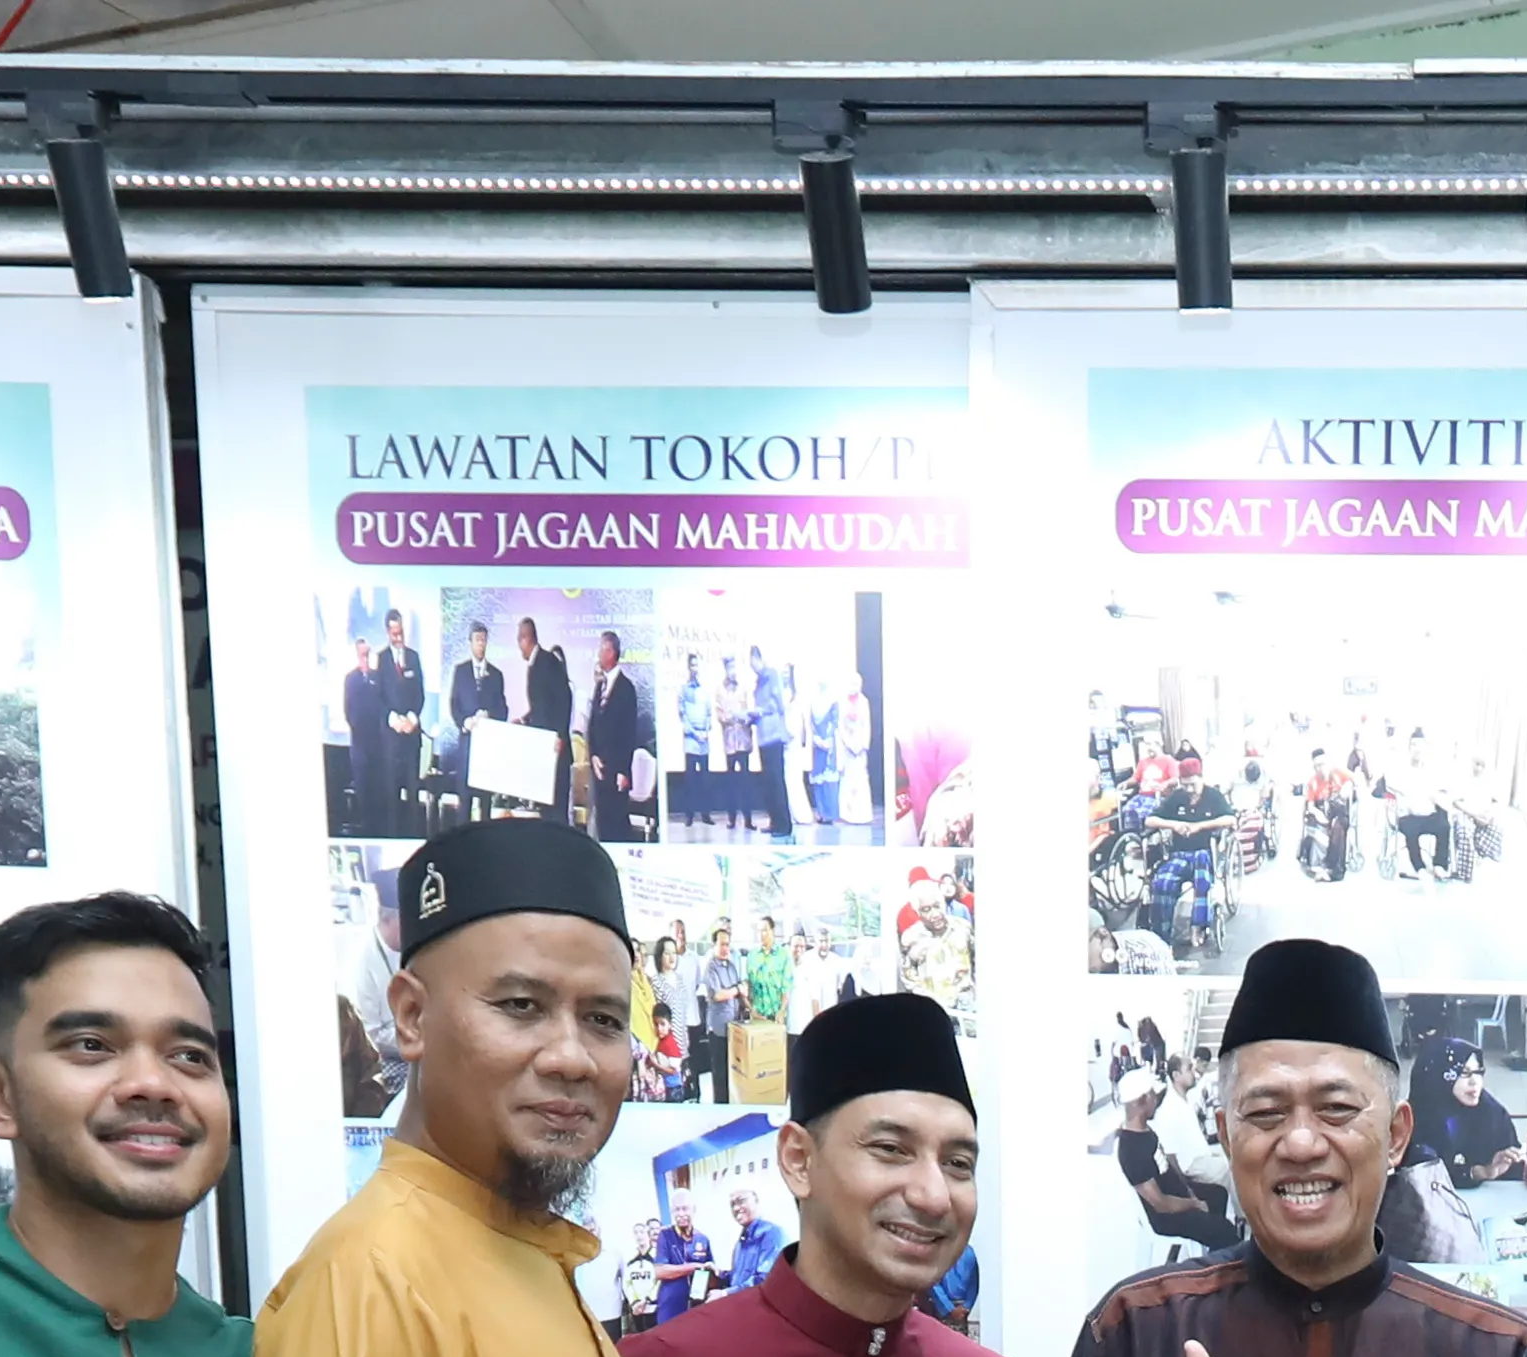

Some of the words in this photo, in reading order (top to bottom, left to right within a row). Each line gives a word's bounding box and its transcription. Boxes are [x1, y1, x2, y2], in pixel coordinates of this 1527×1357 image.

[346, 434, 608, 481] LAWATAN
[1258, 418, 1525, 466] AKTIVITI
[350, 510, 482, 549] PUSAT
[495, 511, 661, 558] JAGAAN
[675, 512, 961, 552] MAHMUDAH
[1130, 498, 1271, 537] PUSAT
[1281, 498, 1460, 546] JAGAAN
